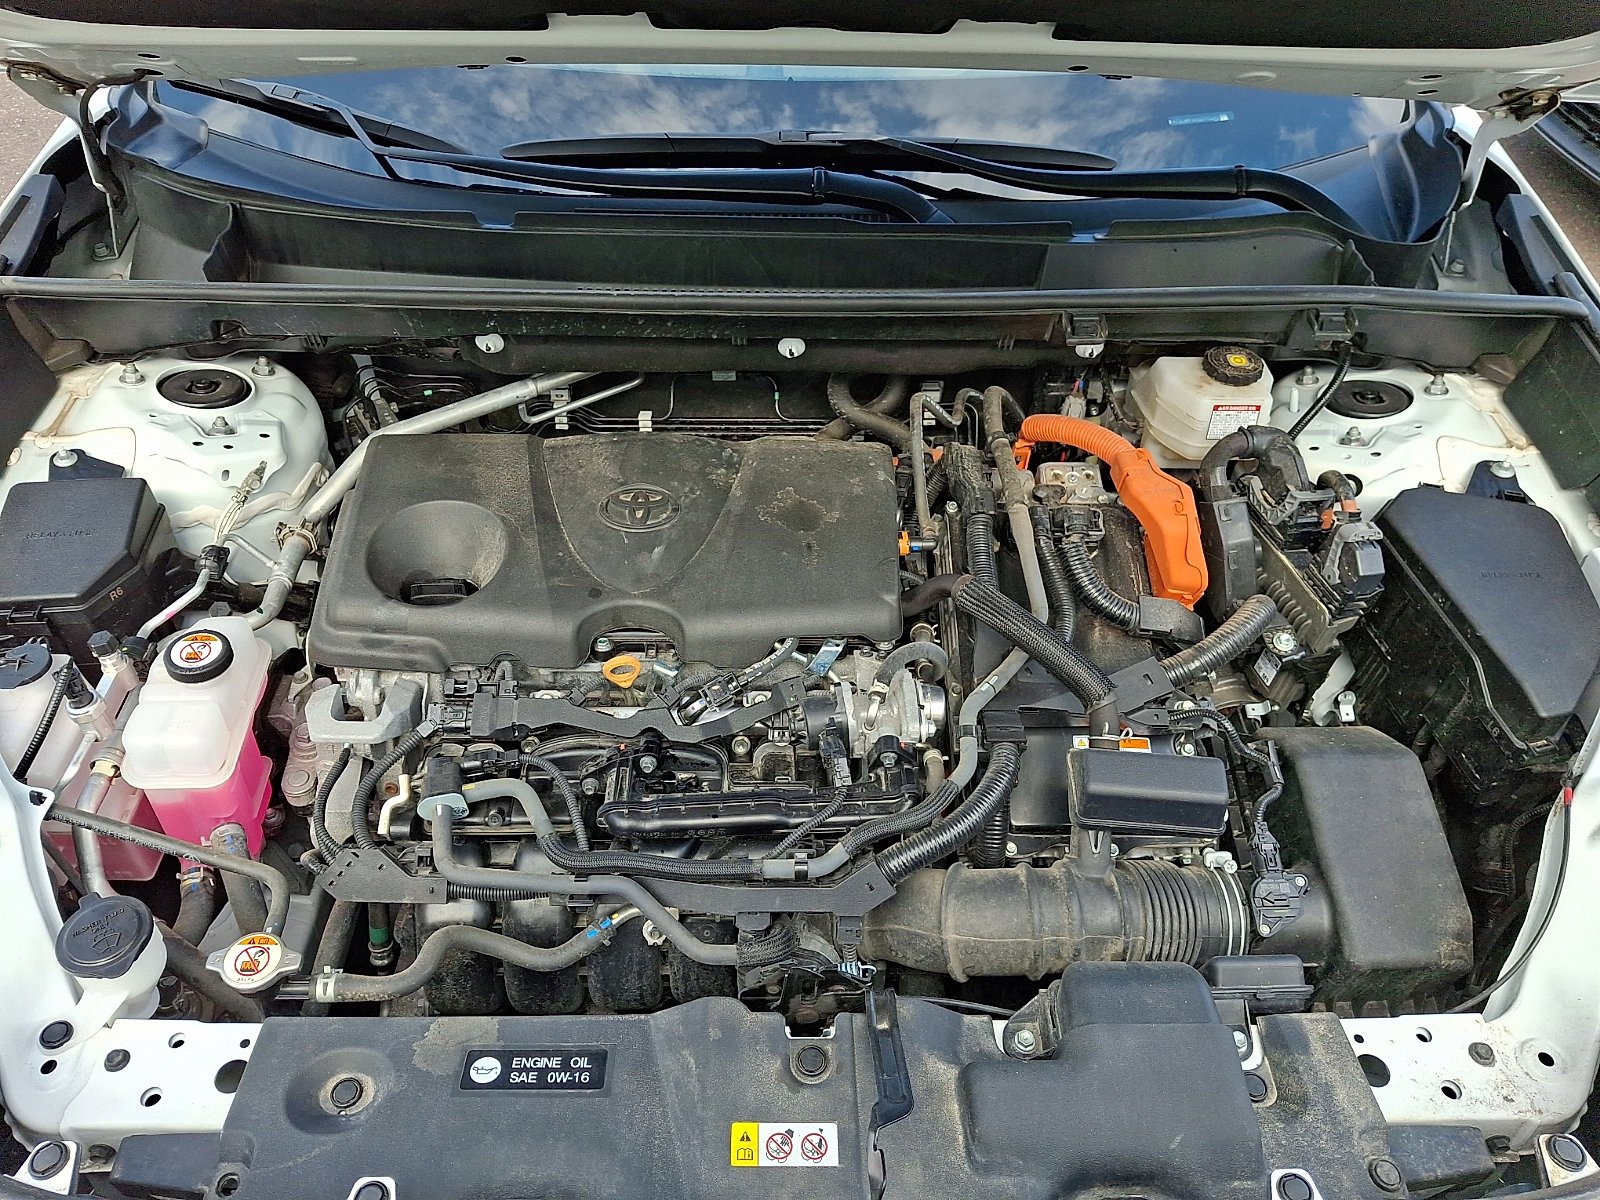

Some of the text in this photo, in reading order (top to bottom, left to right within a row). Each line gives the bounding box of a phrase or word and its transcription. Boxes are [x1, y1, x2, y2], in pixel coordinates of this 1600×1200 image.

[109, 586, 124, 601] R6
[511, 1057, 592, 1069] ENGINE OIL
[509, 1071, 590, 1083] SAE 0W-16
